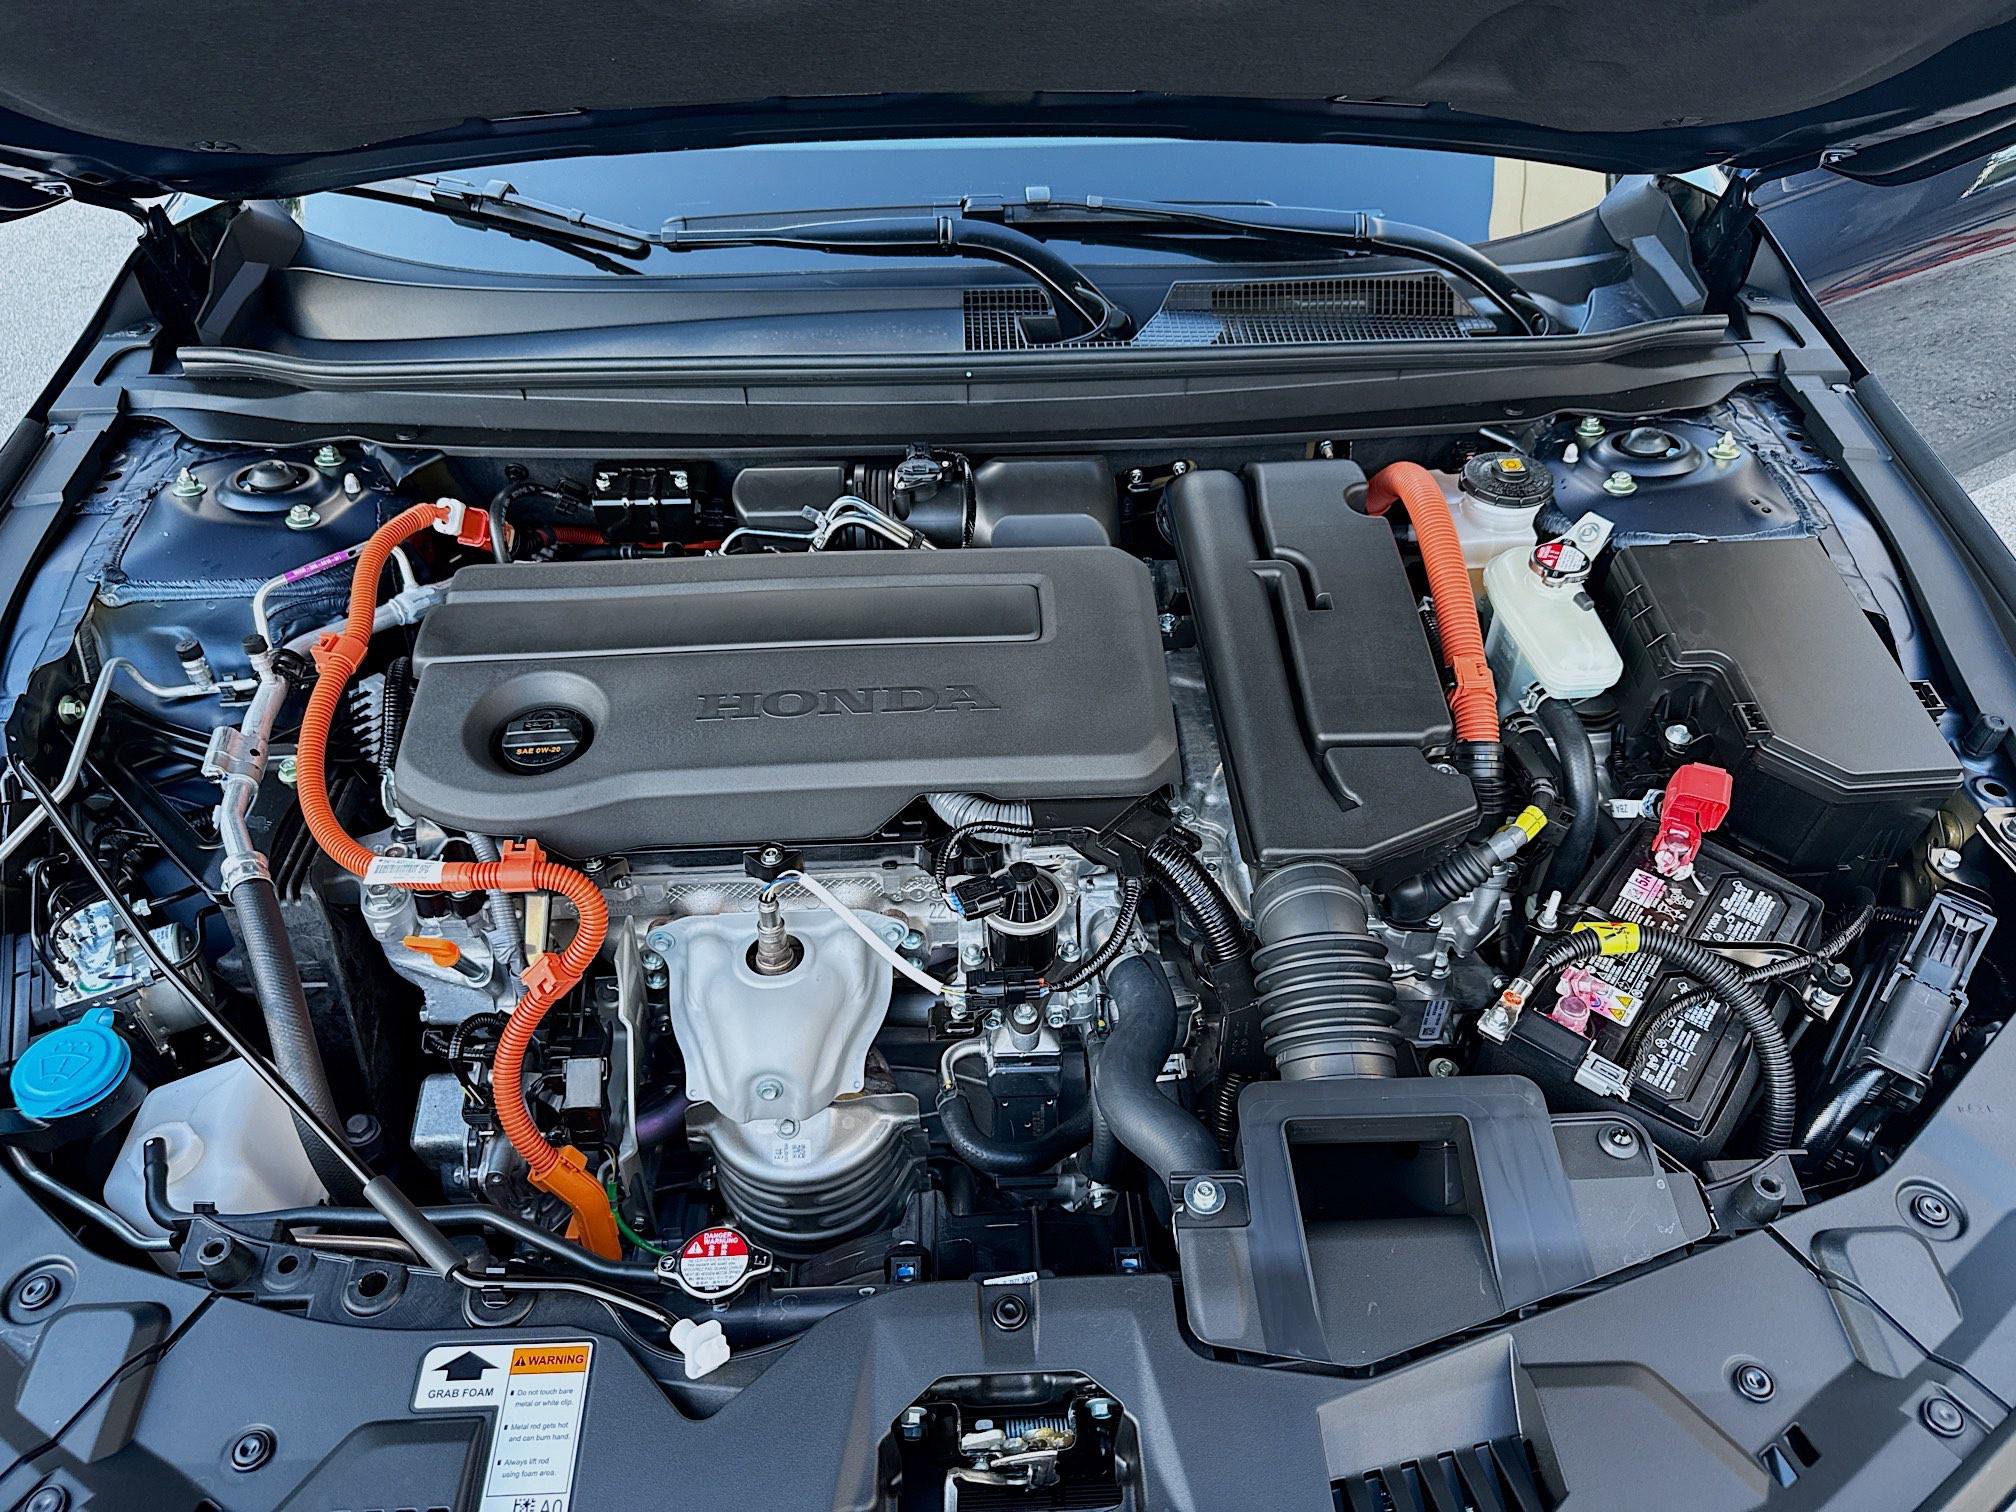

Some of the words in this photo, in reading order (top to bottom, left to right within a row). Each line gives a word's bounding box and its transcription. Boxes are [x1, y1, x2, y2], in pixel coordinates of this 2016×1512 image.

[696, 684, 1000, 722] HONDA
[516, 747, 534, 755] SAE
[535, 746, 561, 754] 0W-20
[1636, 873, 1652, 887] 5A
[528, 1354, 584, 1366] WARNING
[428, 1389, 459, 1399] GRAB
[462, 1388, 494, 1397] FOAM
[542, 1423, 556, 1431] gets
[504, 1459, 527, 1467] Always
[502, 1471, 520, 1479] using
